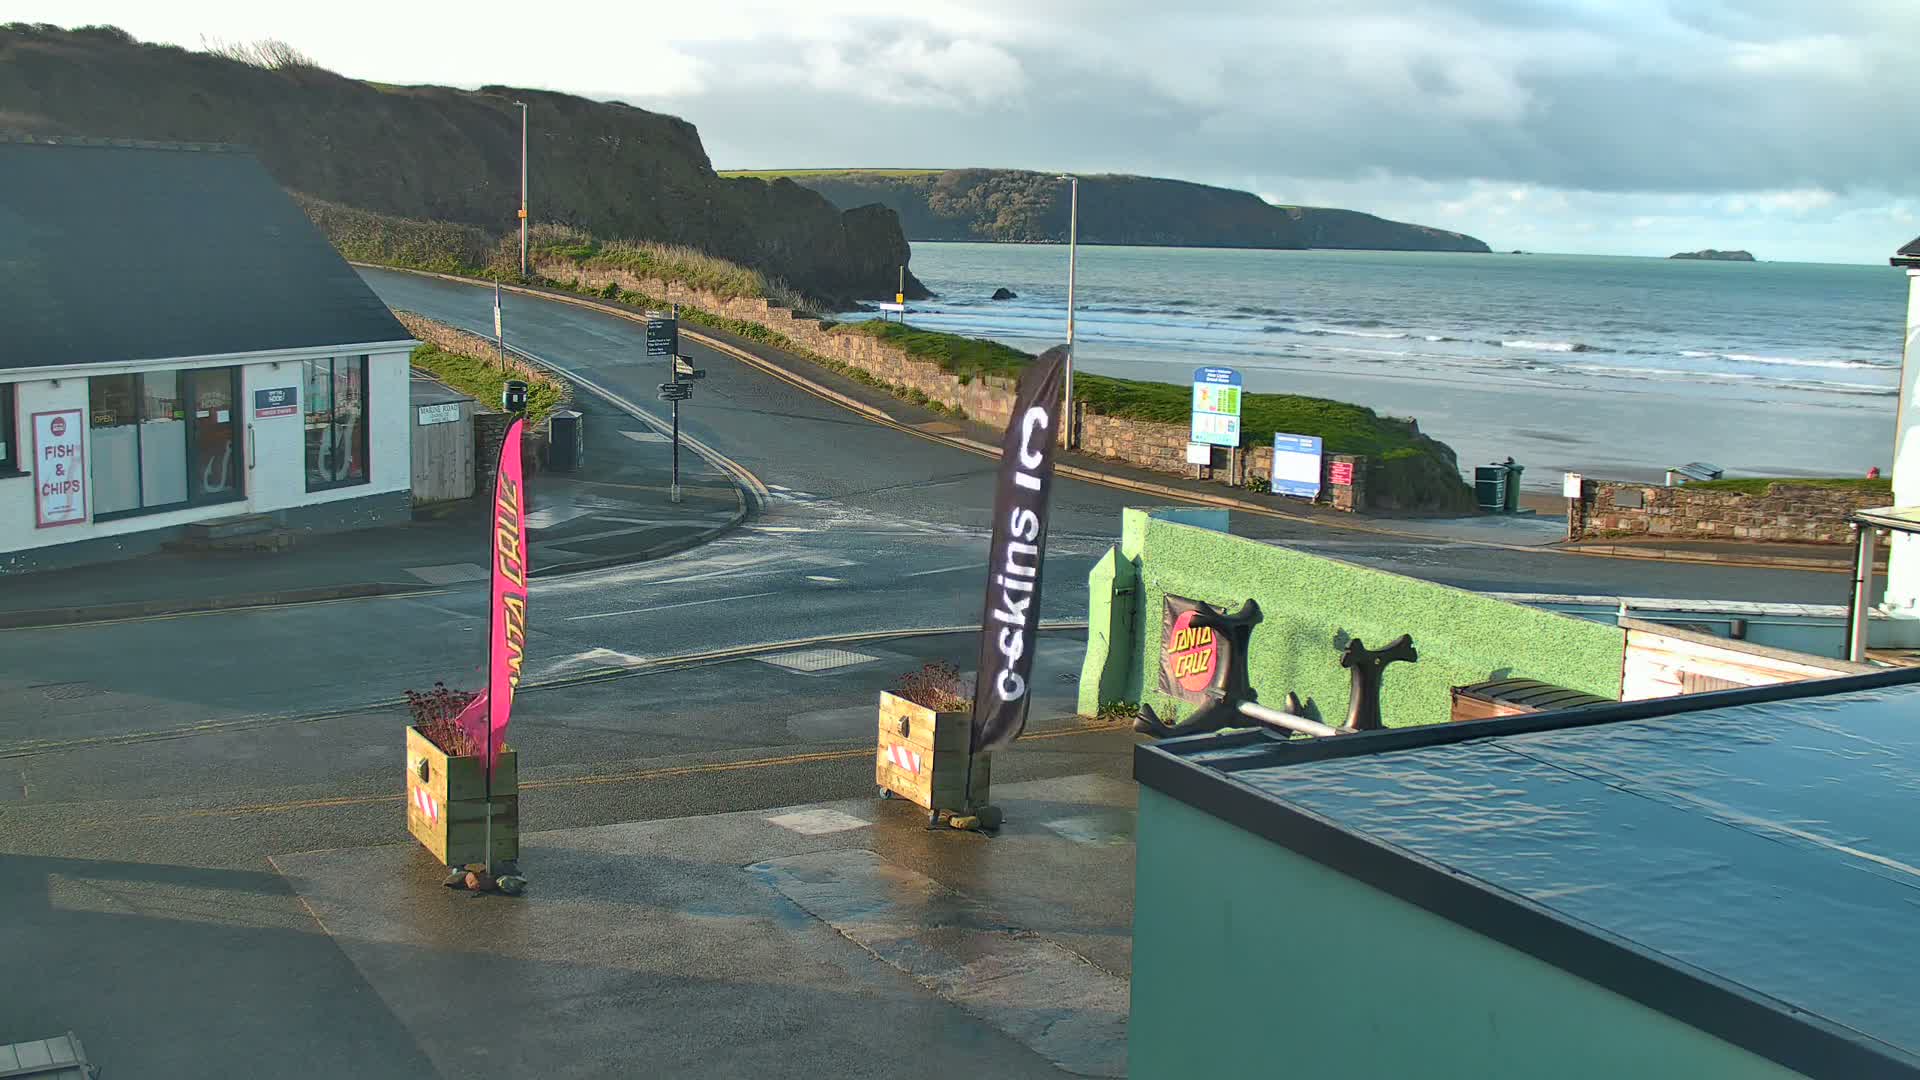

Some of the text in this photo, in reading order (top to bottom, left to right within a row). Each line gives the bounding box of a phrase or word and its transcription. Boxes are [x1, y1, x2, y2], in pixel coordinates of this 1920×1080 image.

[94, 415, 113, 423] OPEN
[45, 444, 75, 460] FISH
[55, 463, 65, 476] &
[42, 480, 80, 496] CHIPS
[498, 475, 523, 588] CRUZ
[1168, 626, 1212, 654] SANTA
[1175, 648, 1213, 678] CRUZ
